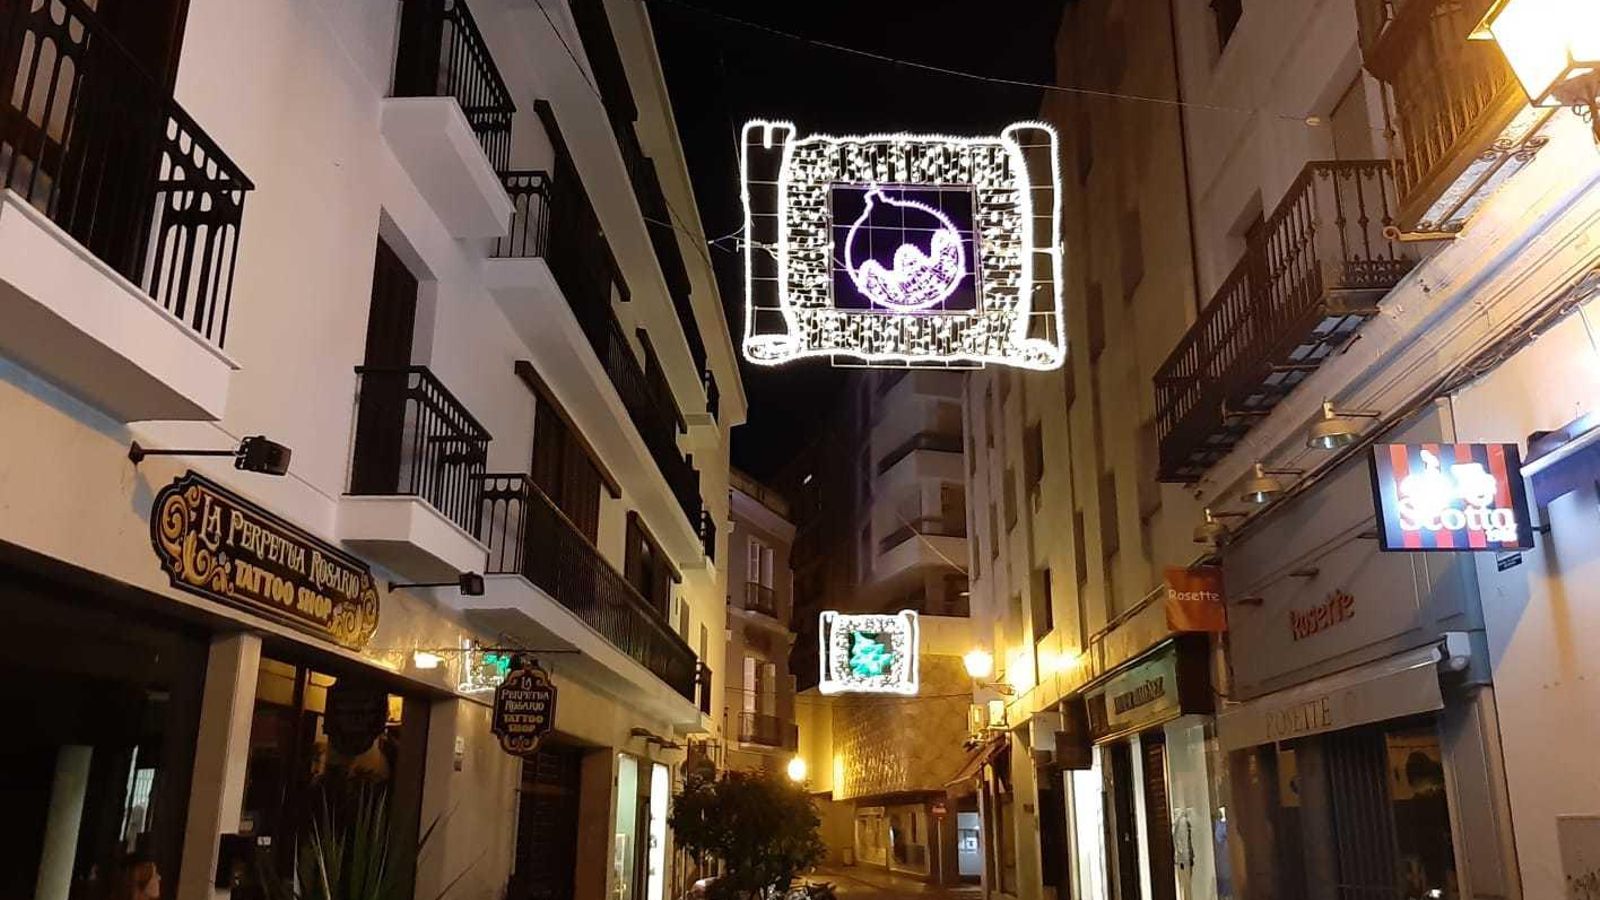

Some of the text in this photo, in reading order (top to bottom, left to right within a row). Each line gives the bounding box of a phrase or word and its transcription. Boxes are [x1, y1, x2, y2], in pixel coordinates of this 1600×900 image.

[200, 493, 360, 600] LA PERPETUA ROSARIO
[235, 559, 333, 620] TATTOO SHOP
[1168, 590, 1220, 602] Rosette
[504, 714, 544, 723] TATTOO
[1265, 695, 1332, 738] ROSETTE
